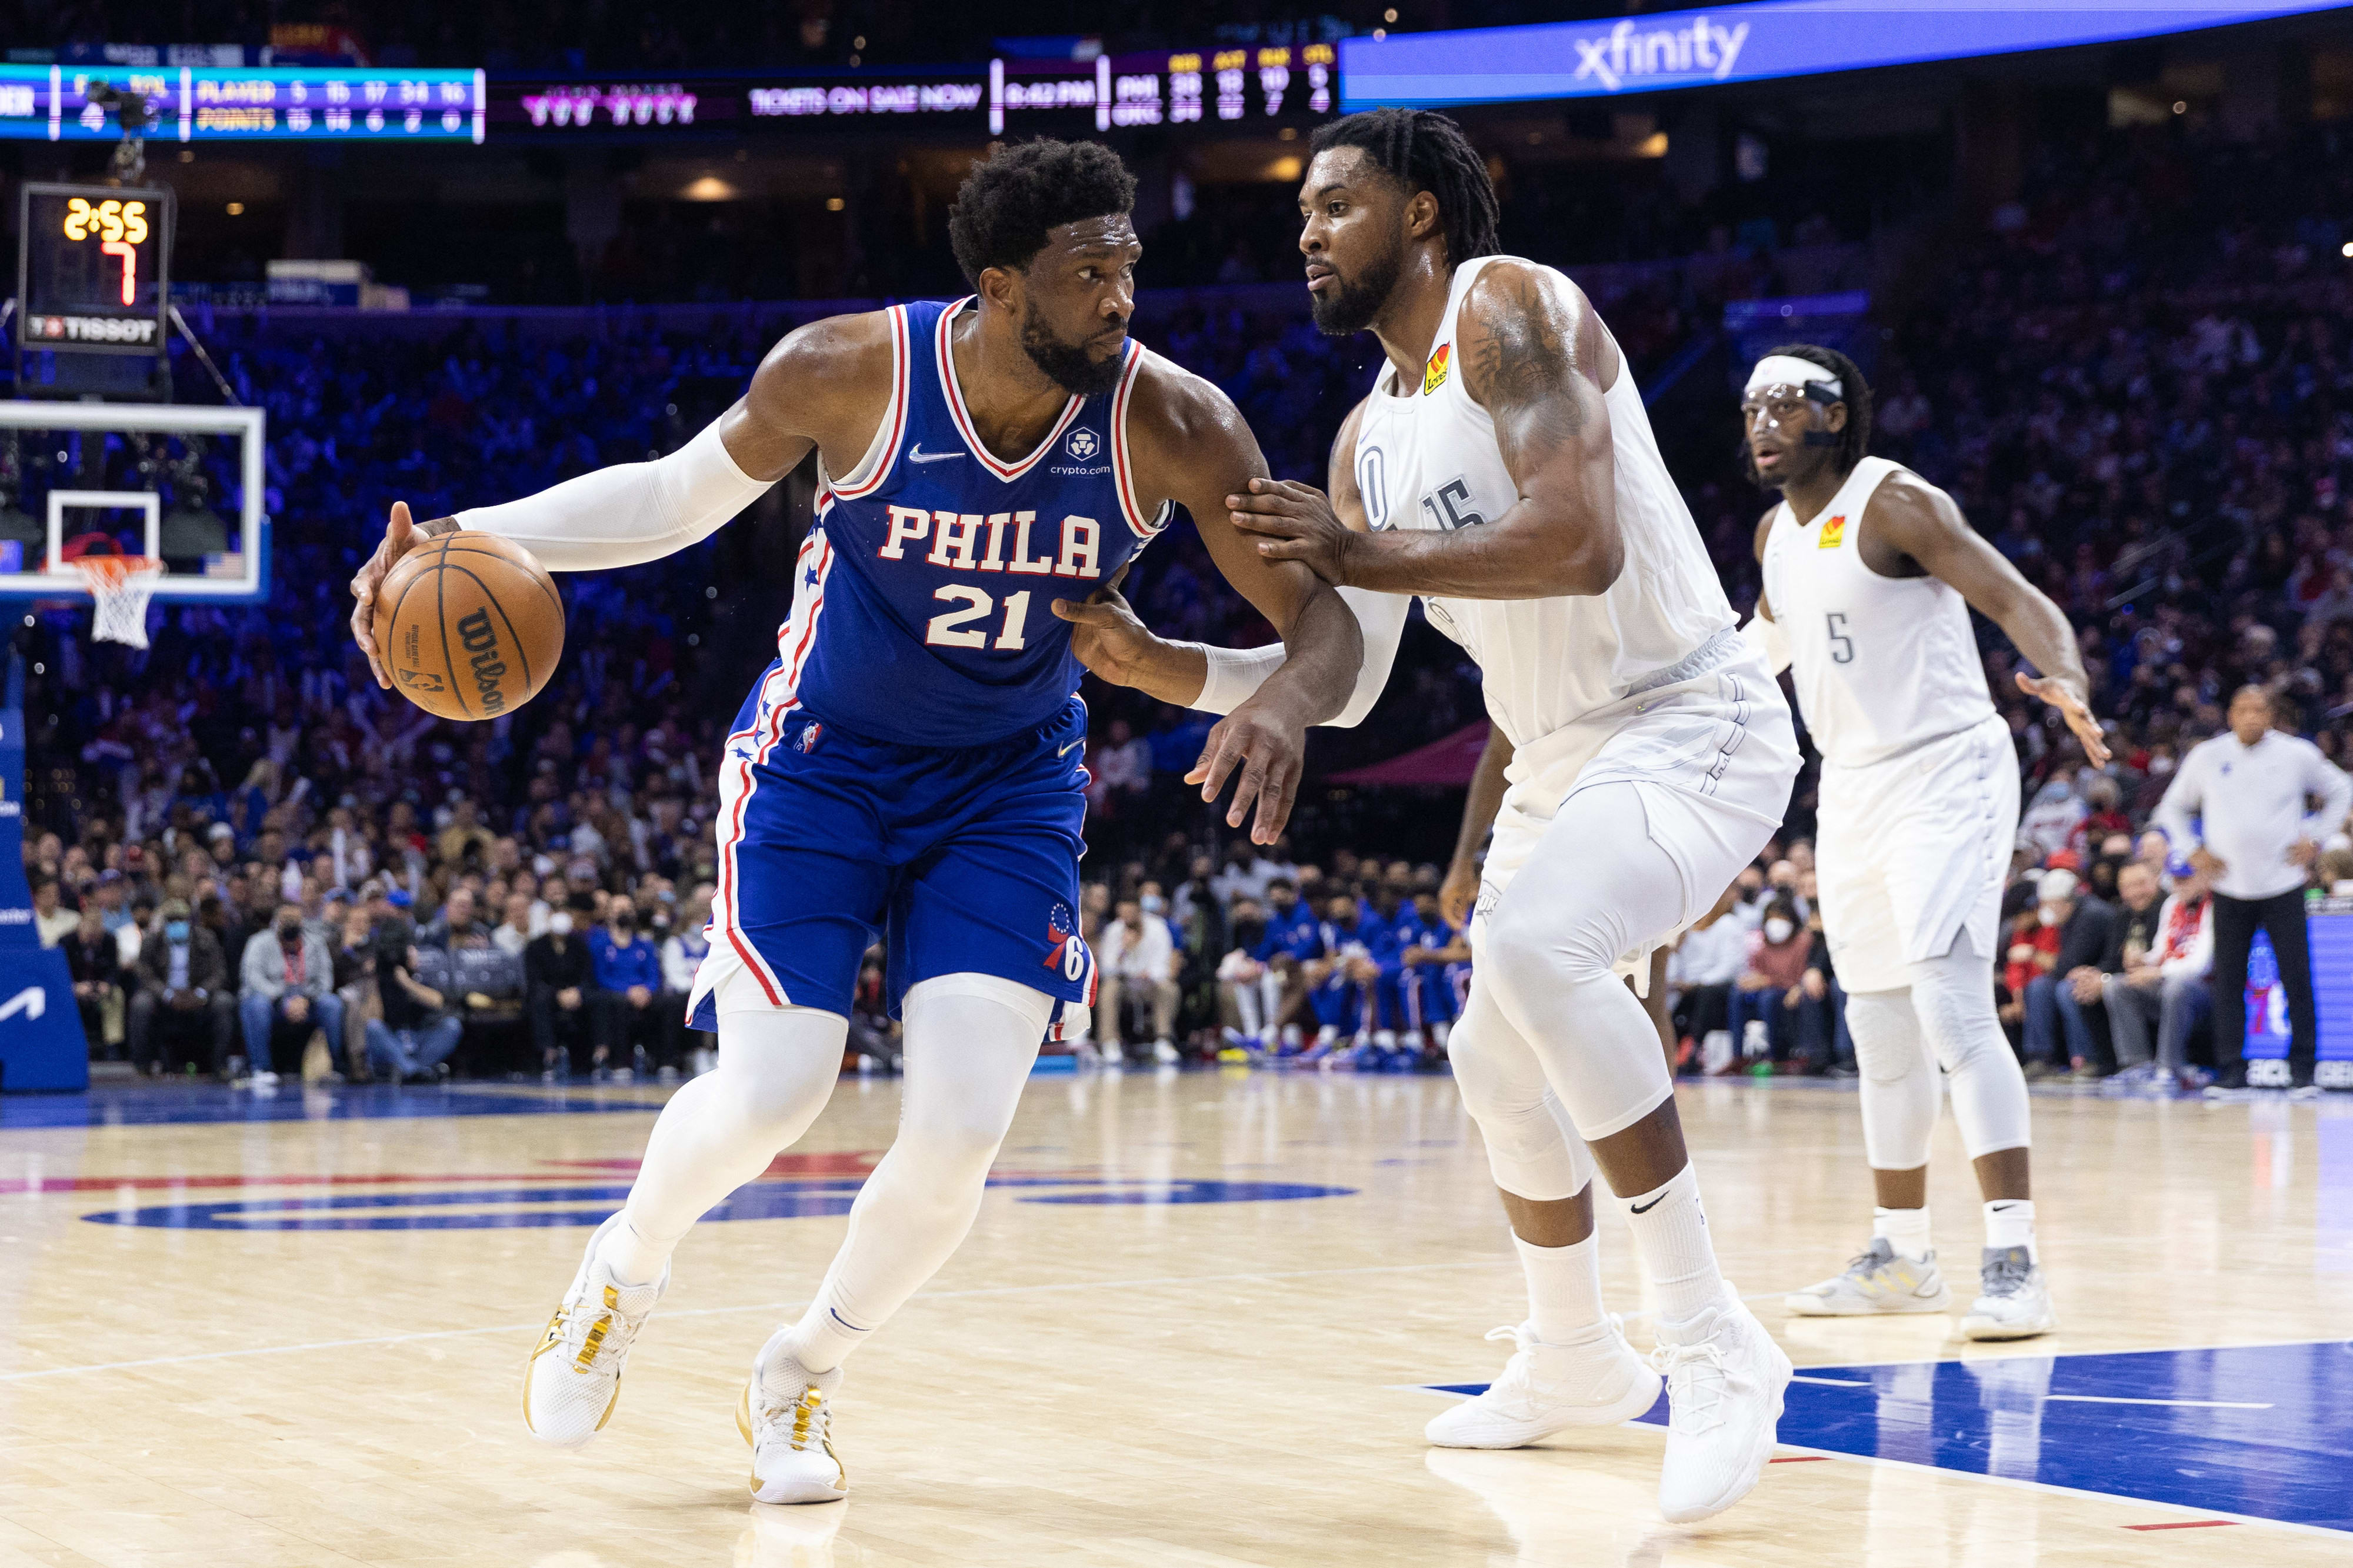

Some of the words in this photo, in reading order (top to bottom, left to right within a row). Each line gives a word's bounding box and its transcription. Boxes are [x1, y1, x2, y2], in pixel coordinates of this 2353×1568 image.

[1575, 17, 1750, 90] xfinity
[196, 79, 276, 104] PLAYER
[748, 88, 827, 116] TICKETS
[827, 86, 868, 115] ON
[869, 85, 919, 114] SALE
[920, 83, 982, 112] NOW
[196, 108, 276, 131] POINTS
[64, 198, 148, 244] 2:55
[101, 241, 136, 306] 7
[65, 317, 157, 343] TISSOT
[1051, 465, 1110, 475] crypto.com
[877, 504, 1101, 580] PHILA
[925, 583, 1031, 650] 21
[1826, 613, 1854, 664] 5
[458, 606, 506, 715] Wilson
